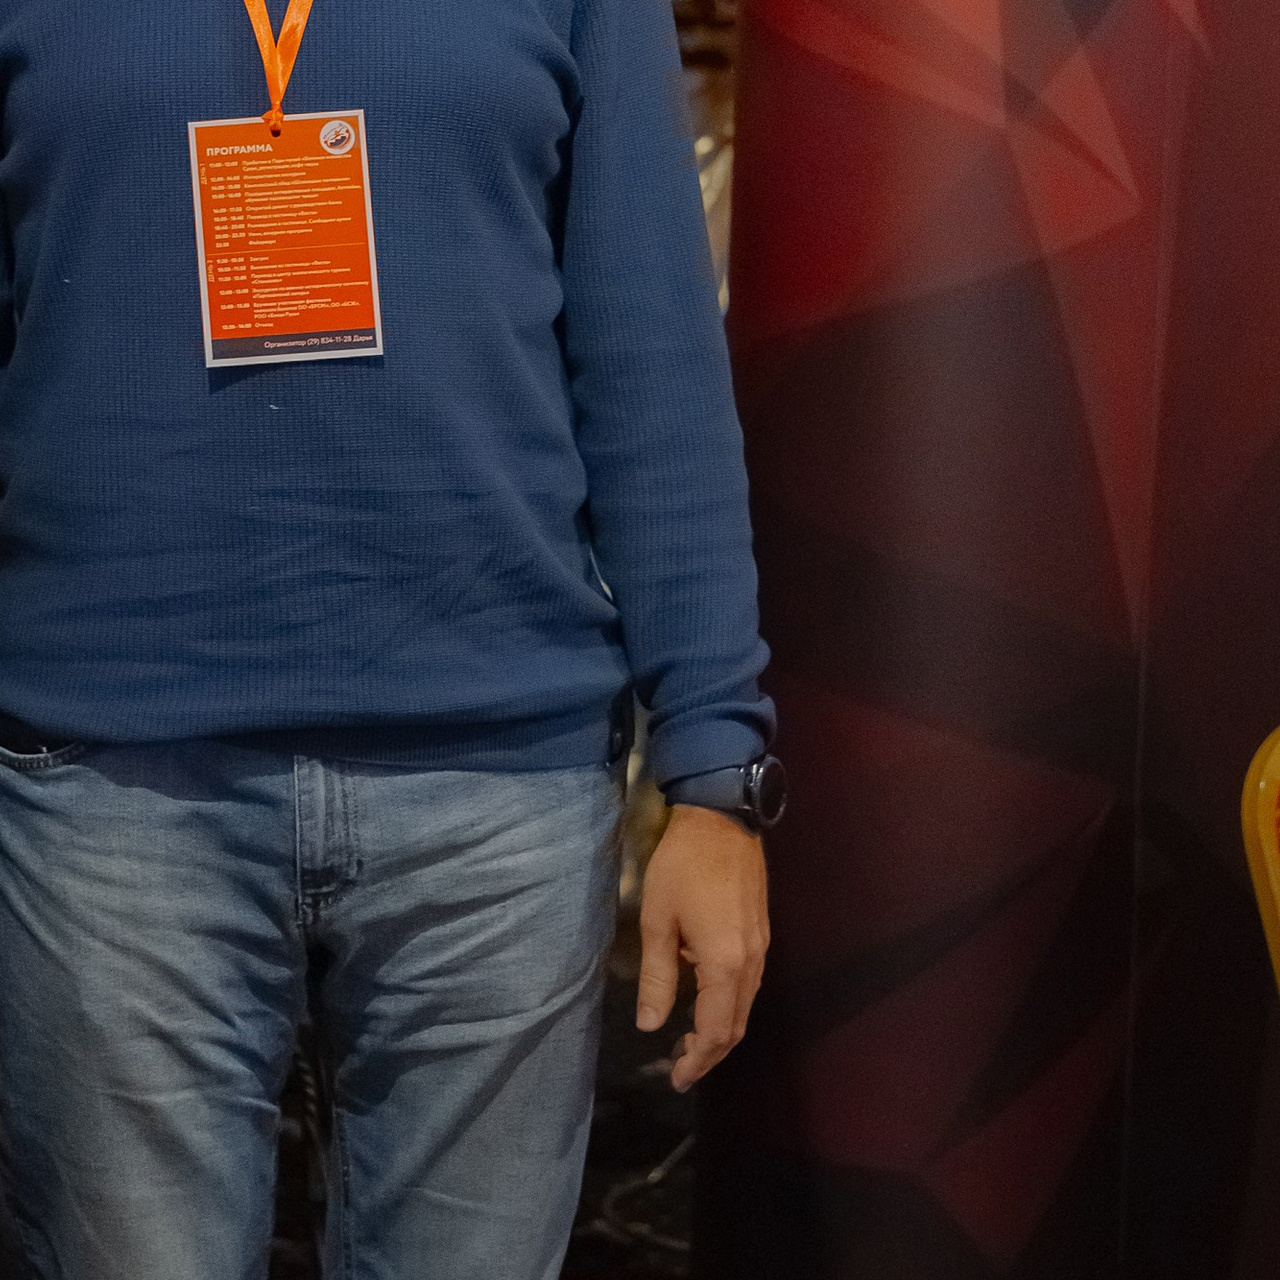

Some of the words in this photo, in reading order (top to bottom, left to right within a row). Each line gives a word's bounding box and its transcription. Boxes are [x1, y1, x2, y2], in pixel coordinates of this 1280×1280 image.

[205, 143, 273, 156] ПРОГРАММА
[263, 338, 306, 349] Организатор
[306, 337, 320, 345] (29)
[319, 334, 352, 344] 834-11-28
